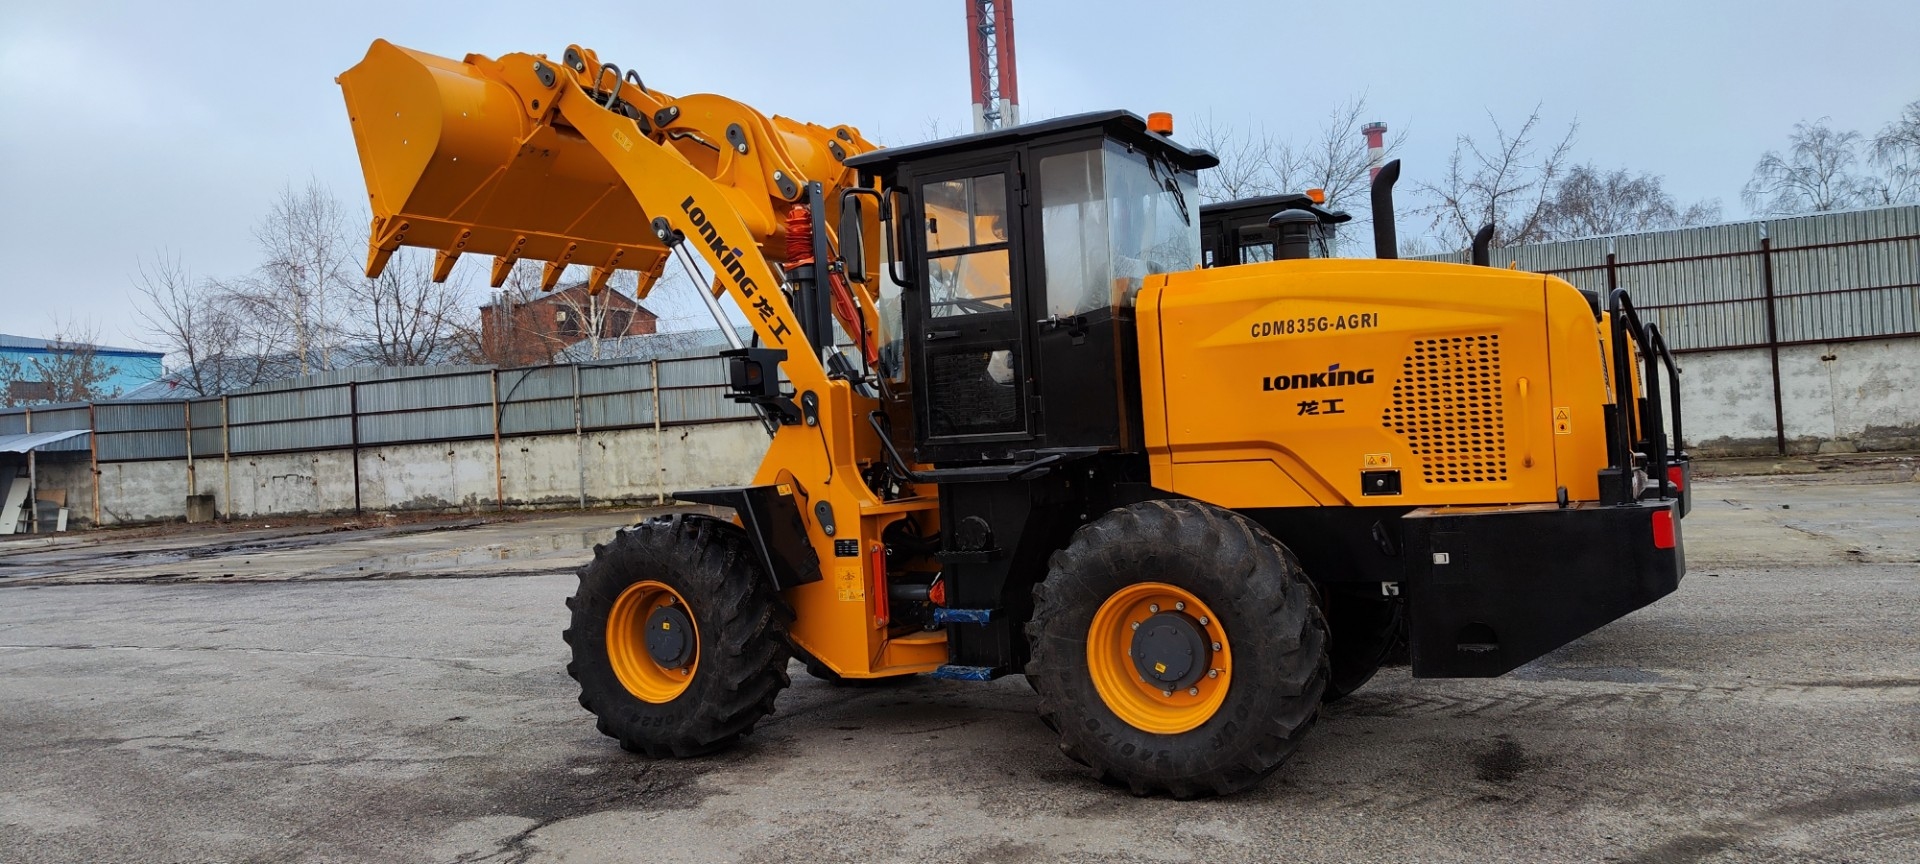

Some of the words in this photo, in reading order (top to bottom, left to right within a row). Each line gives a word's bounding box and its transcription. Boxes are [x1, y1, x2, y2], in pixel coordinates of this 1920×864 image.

[753, 295, 792, 345] 龙工
[1251, 312, 1378, 338] CDM835G-AGRI
[1297, 398, 1345, 416] 龙工
